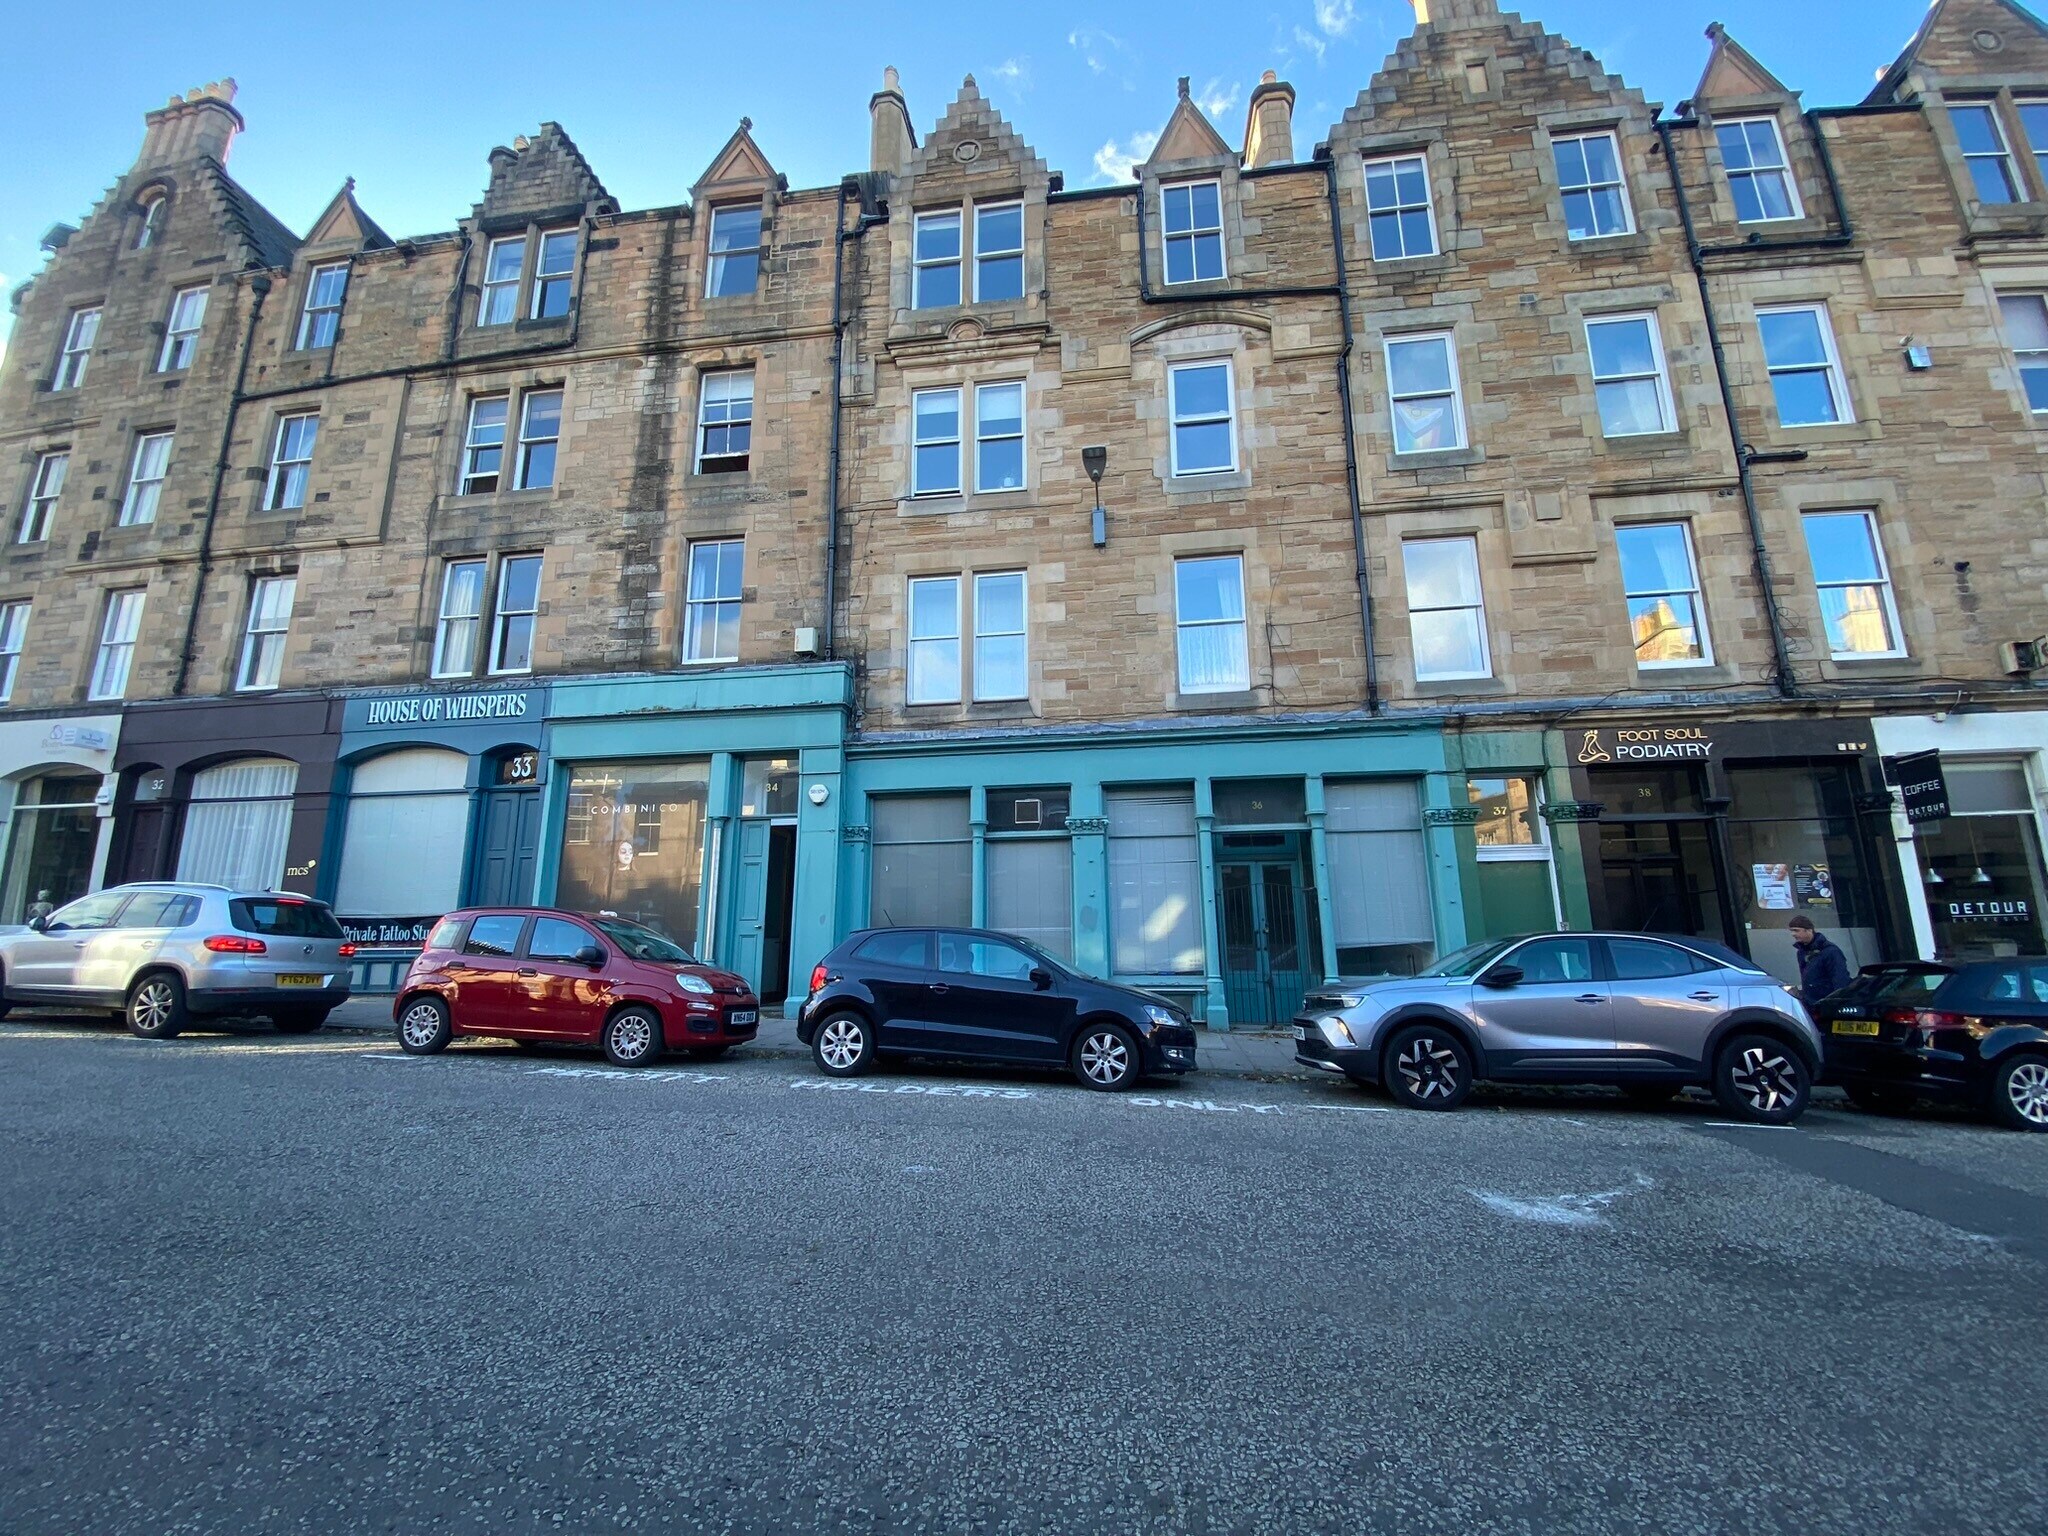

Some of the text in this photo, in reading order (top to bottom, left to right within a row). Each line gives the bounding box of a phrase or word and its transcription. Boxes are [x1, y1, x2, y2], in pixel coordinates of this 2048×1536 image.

[367, 693, 527, 725] HOUSE OF WHISPERS
[1617, 728, 1708, 742] FOOT SOUL
[1615, 742, 1713, 759] PODIATRY
[511, 755, 532, 778] 33
[766, 783, 778, 792] 34
[1638, 788, 1652, 797] 38
[1904, 779, 1941, 796] COFFEE
[590, 803, 679, 815] COMBINICO
[1251, 800, 1263, 810] 36
[1493, 806, 1507, 816] 37
[1908, 802, 1946, 816] DETOUR
[287, 865, 309, 876] mcs
[1949, 901, 2027, 915] DETOUR
[342, 925, 377, 942] Private
[380, 925, 411, 941] Tattoo
